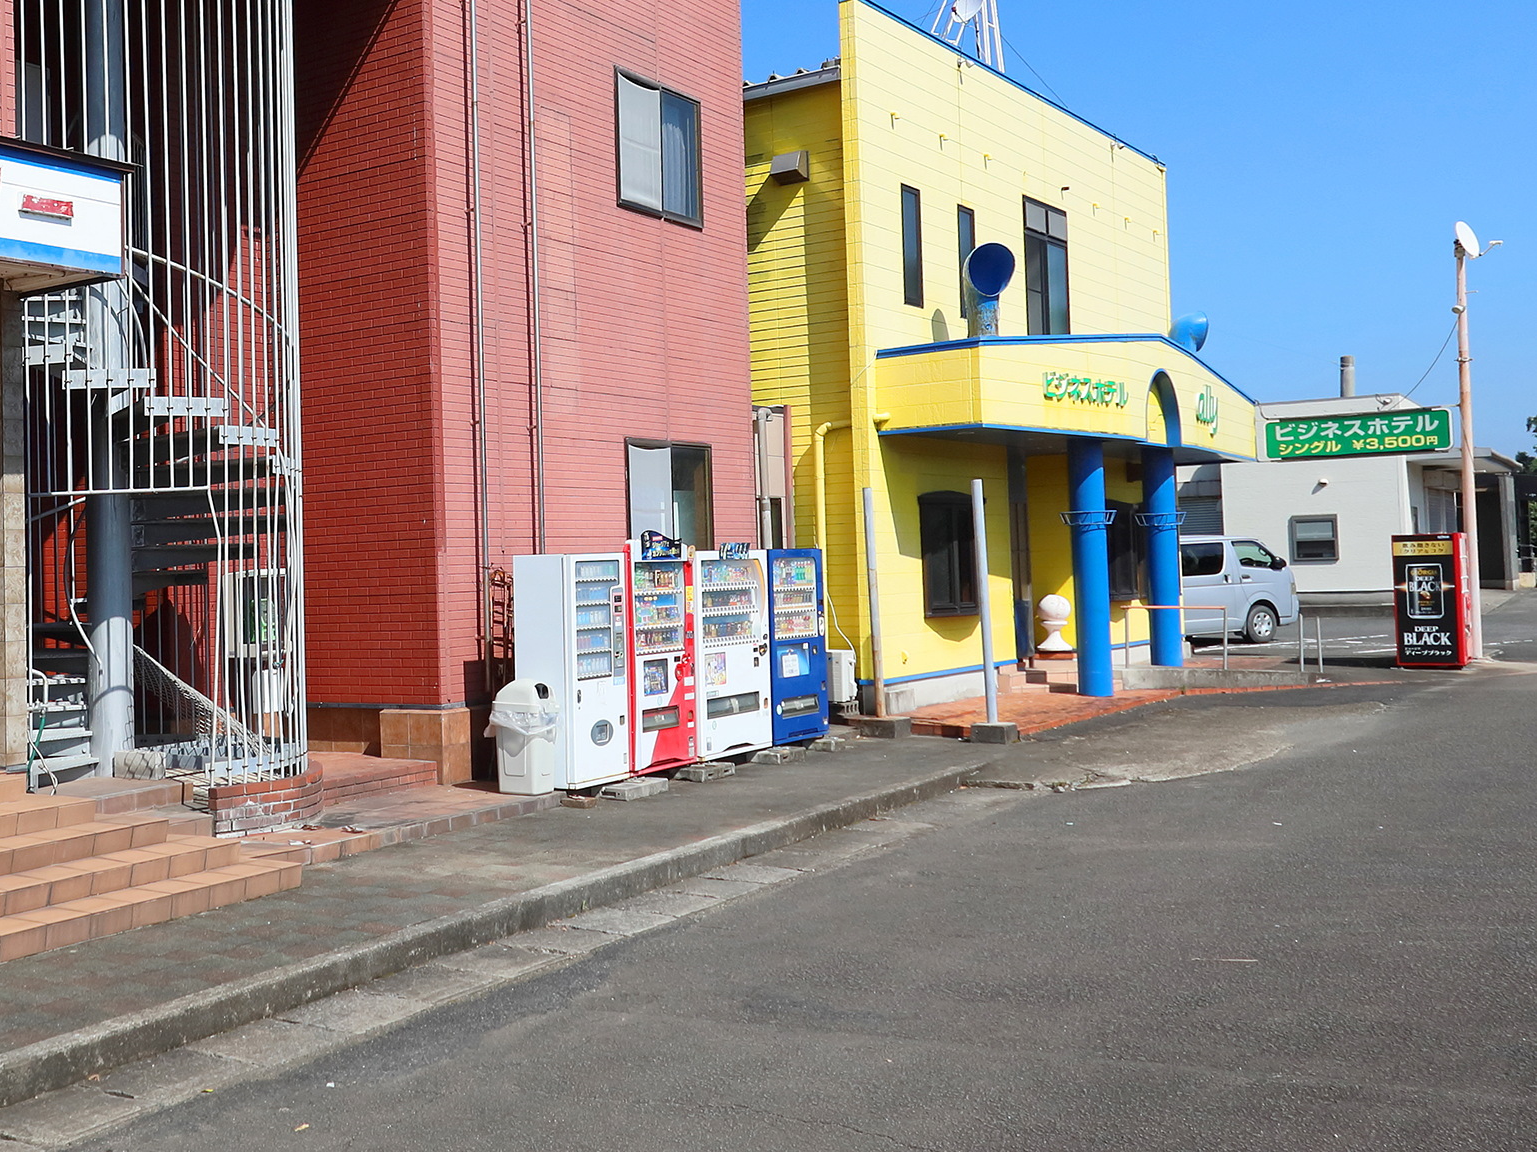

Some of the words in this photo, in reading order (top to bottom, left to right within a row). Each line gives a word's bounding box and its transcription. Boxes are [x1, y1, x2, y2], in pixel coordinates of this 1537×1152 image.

[1042, 371, 1129, 408] ビジネスホテル
[1274, 414, 1439, 442] ビジネスホテル
[1278, 440, 1342, 456] シングル
[1352, 434, 1439, 451] ¥3,500円
[1409, 581, 1441, 592] BLACK
[1403, 632, 1452, 646] BLACK
